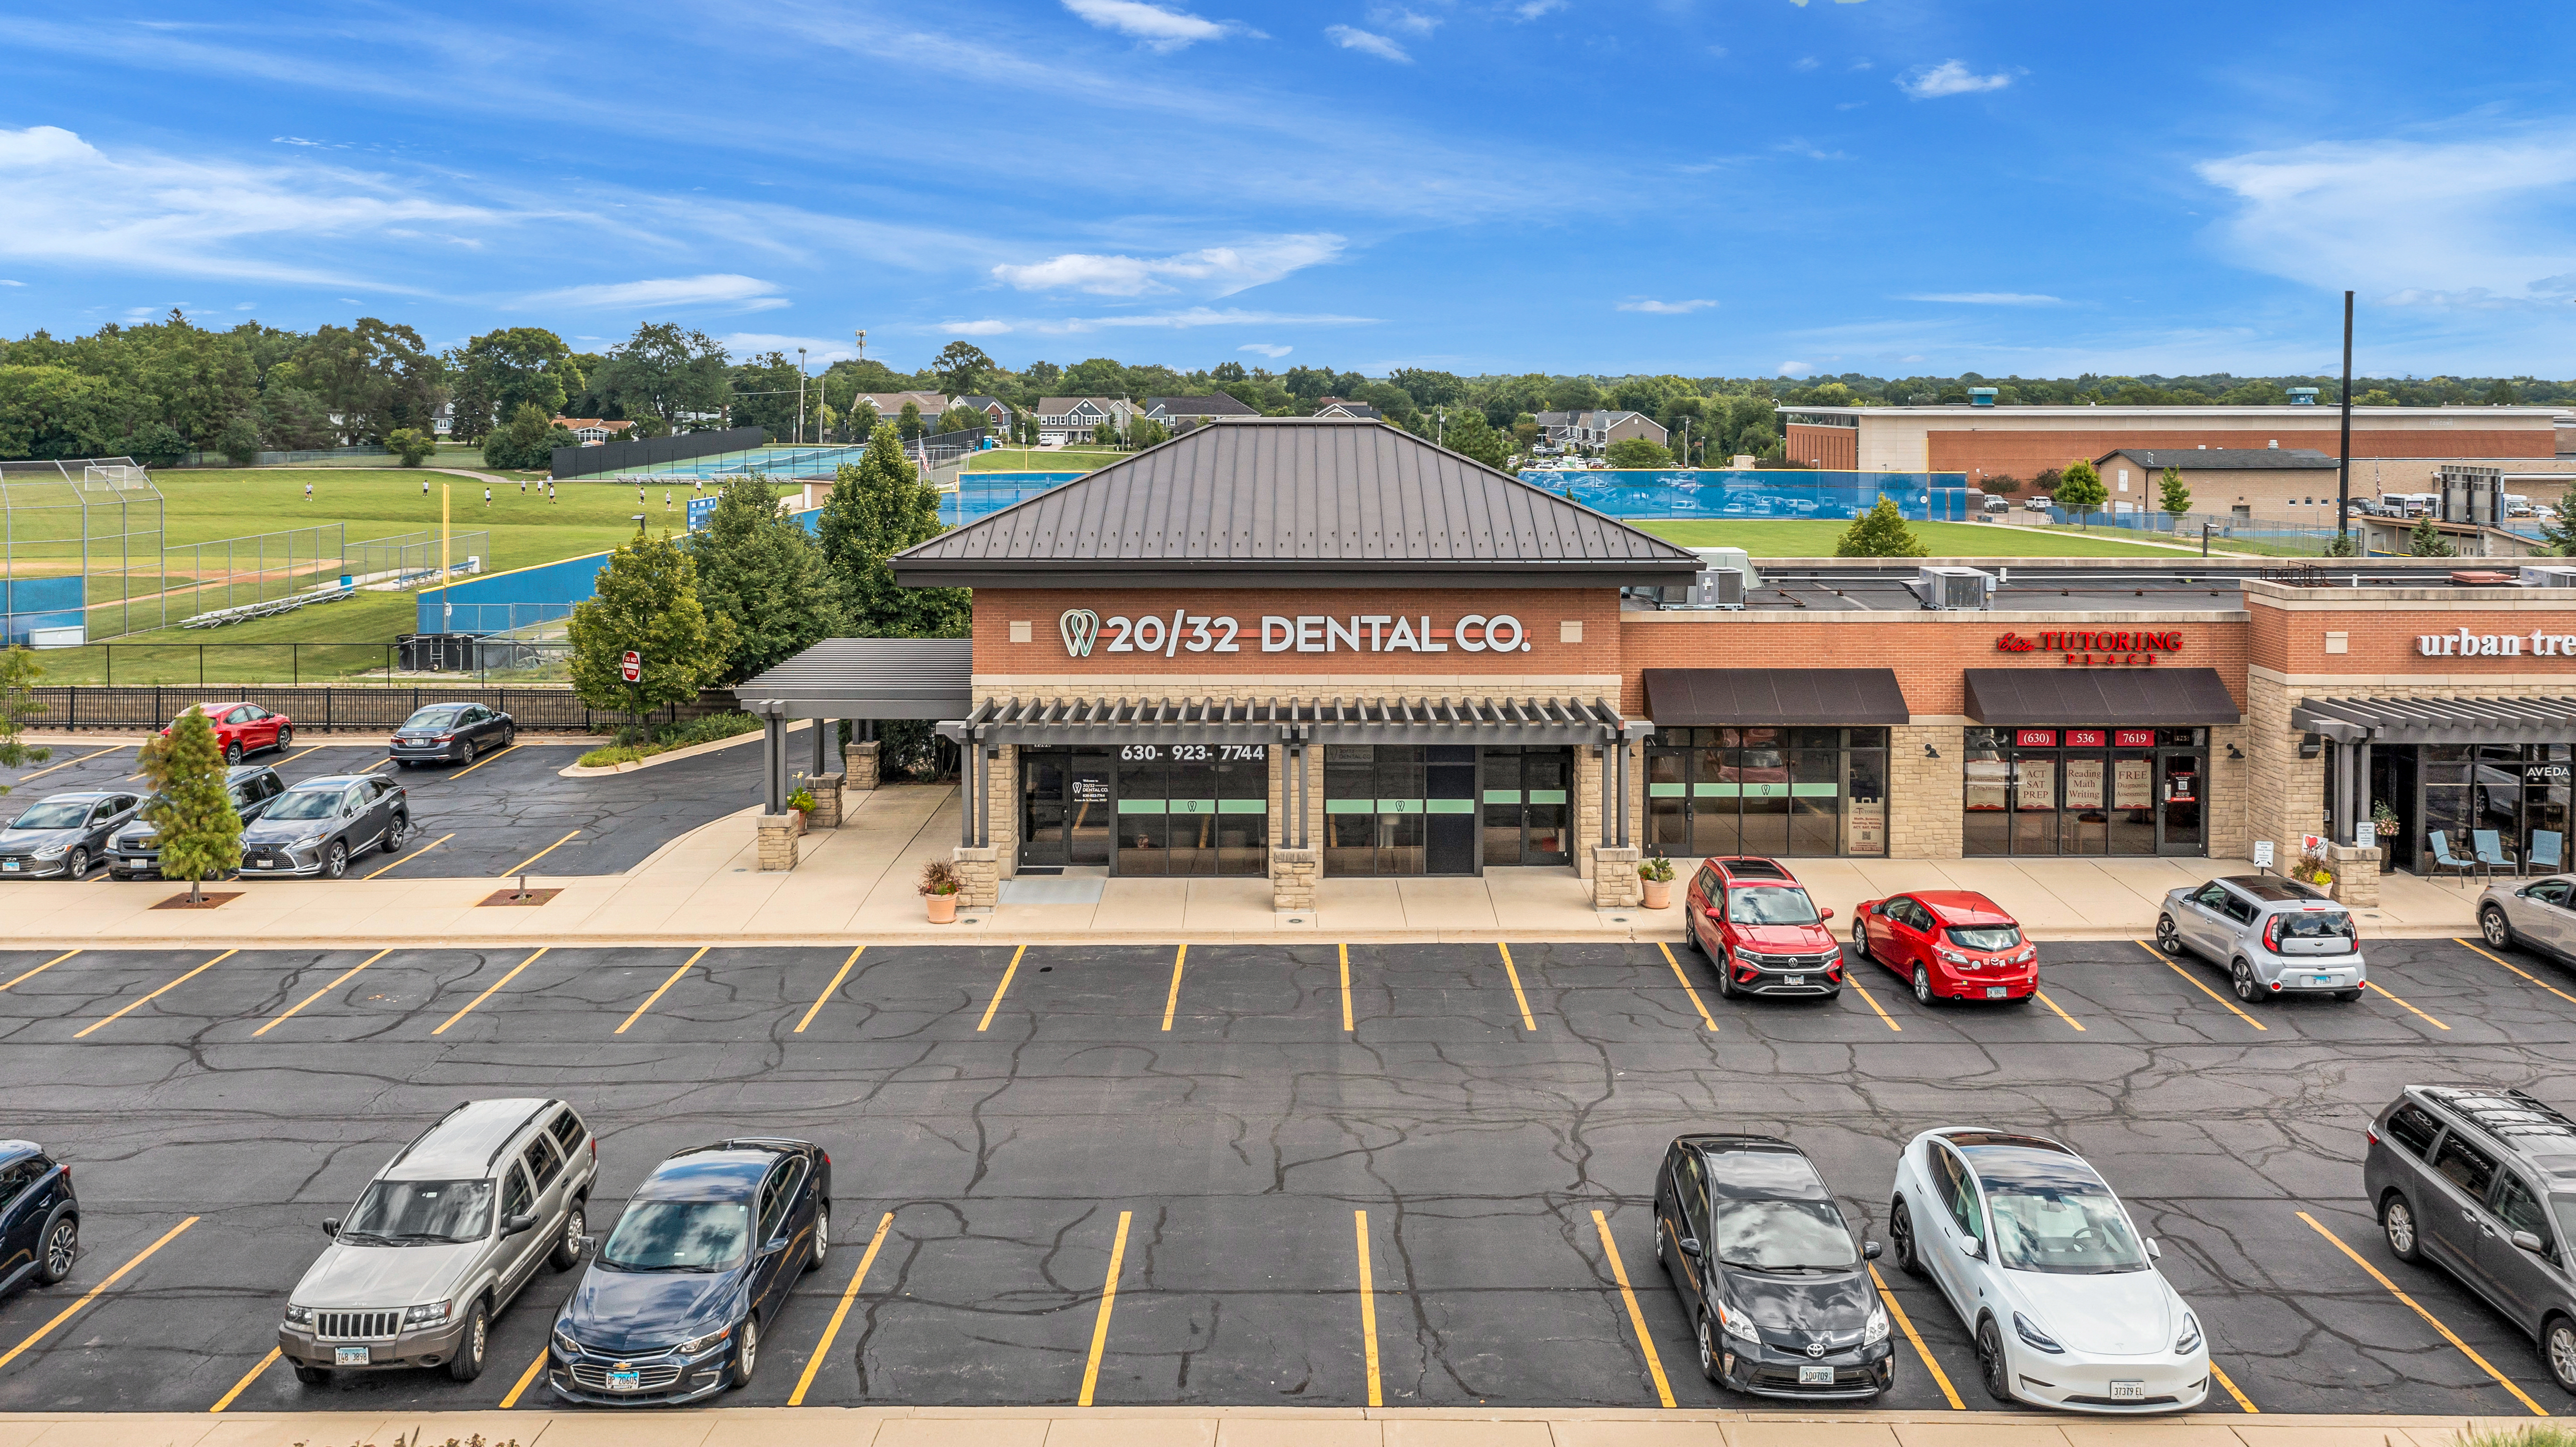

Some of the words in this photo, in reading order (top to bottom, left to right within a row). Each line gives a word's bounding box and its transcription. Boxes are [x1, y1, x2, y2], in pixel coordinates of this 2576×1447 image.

[1106, 609, 1239, 658] 20/32
[1262, 615, 1448, 652] DENTAL
[1455, 615, 1531, 652] CO.
[1998, 632, 2035, 651] Elite
[2040, 632, 2184, 651] TUTORING
[2420, 627, 2521, 656] urban
[2067, 654, 2157, 664] PLACE
[2023, 733, 2049, 745] (630)
[2076, 733, 2094, 743] 536
[2123, 733, 2146, 743] 7619
[1121, 745, 1163, 760] 630-
[1172, 745, 1213, 760] 923-
[1220, 745, 1264, 760] 7744
[2068, 770, 2101, 779] Reading
[2119, 771, 2147, 779] FREE
[2526, 767, 2570, 776] AVEDA
[2069, 790, 2100, 799] Writing
[352, 1353, 367, 1361] 3898
[619, 1376, 637, 1384] 20605
[2114, 1388, 2133, 1396] 37379
[2136, 1388, 2143, 1396] EL
